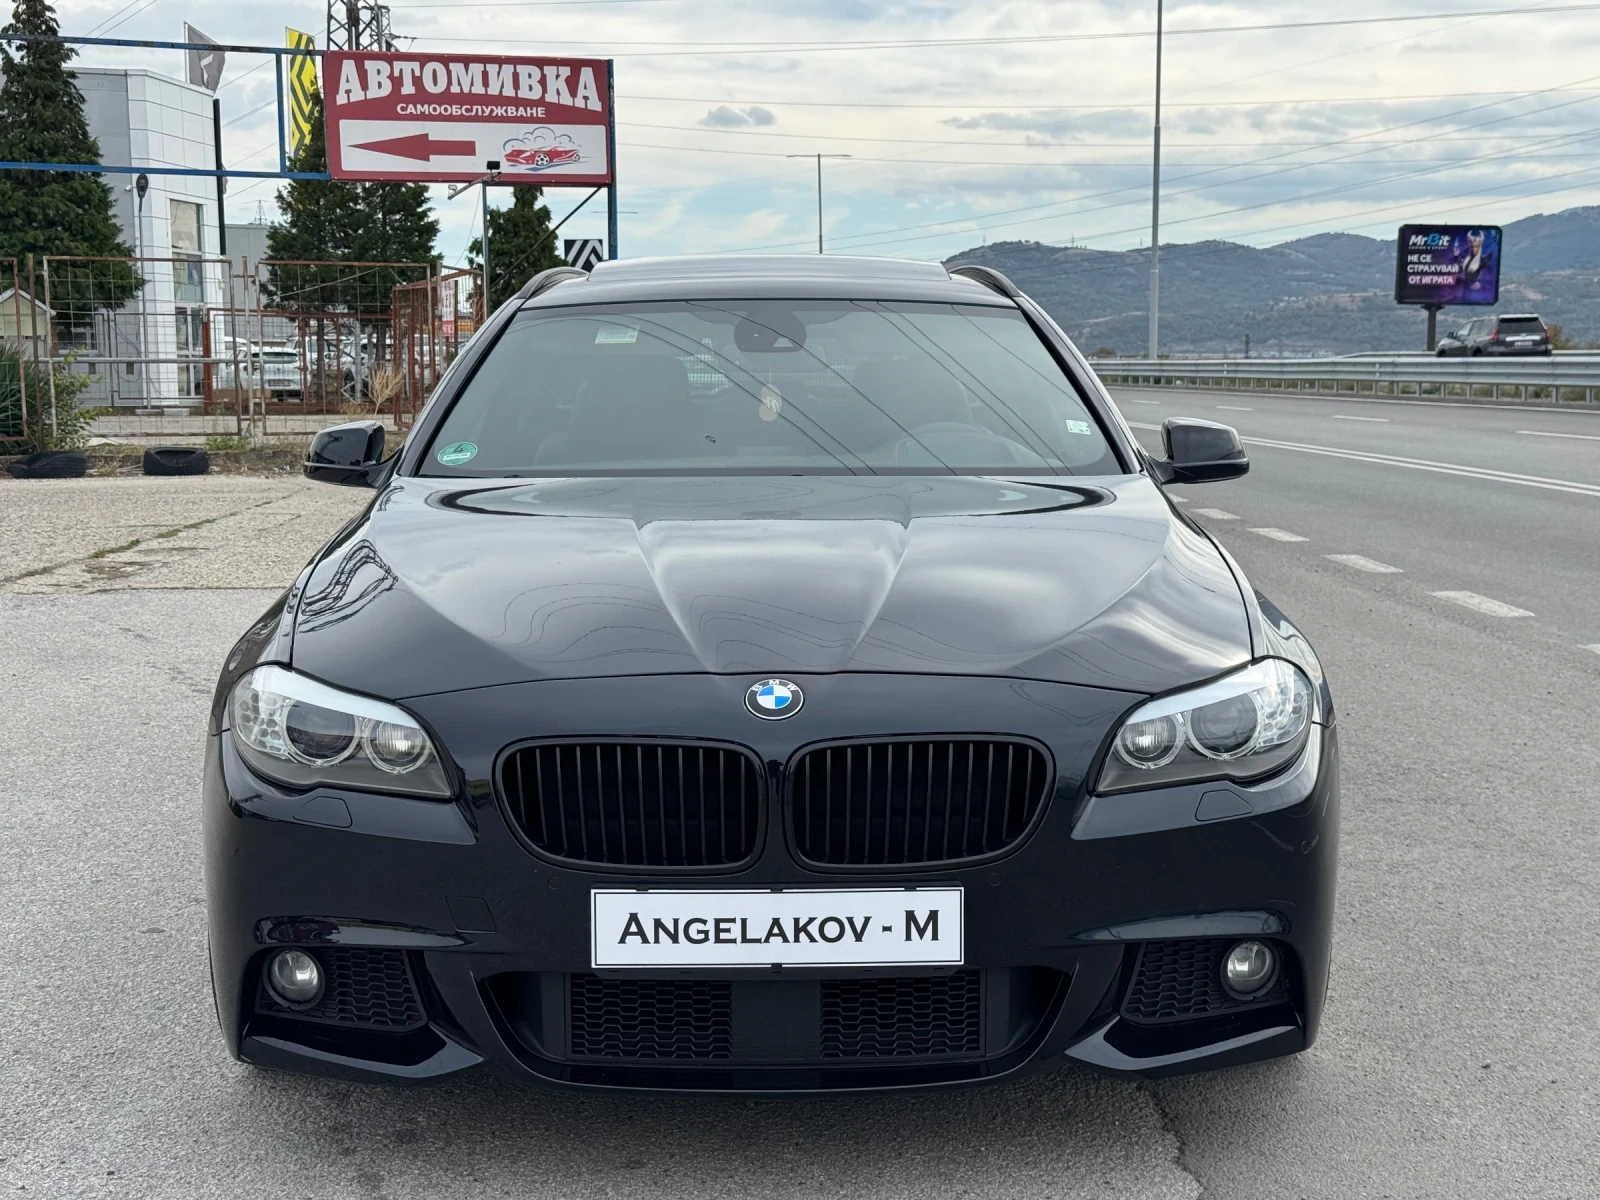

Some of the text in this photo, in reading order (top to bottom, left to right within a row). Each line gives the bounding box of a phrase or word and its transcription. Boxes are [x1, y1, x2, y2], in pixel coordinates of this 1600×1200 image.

[336, 59, 602, 112] АВТОМИВКА
[396, 103, 546, 118] САМООБСЛУЖВАНЕ
[1409, 233, 1451, 246] MrBit
[1407, 254, 1432, 263] НЕ СЕ
[1407, 263, 1459, 273] СТРАХУВАЙ
[1408, 275, 1453, 285] ОТ ИГРАТА
[453, 443, 464, 453] 4
[752, 680, 798, 691] BMW
[904, 909, 940, 942] M
